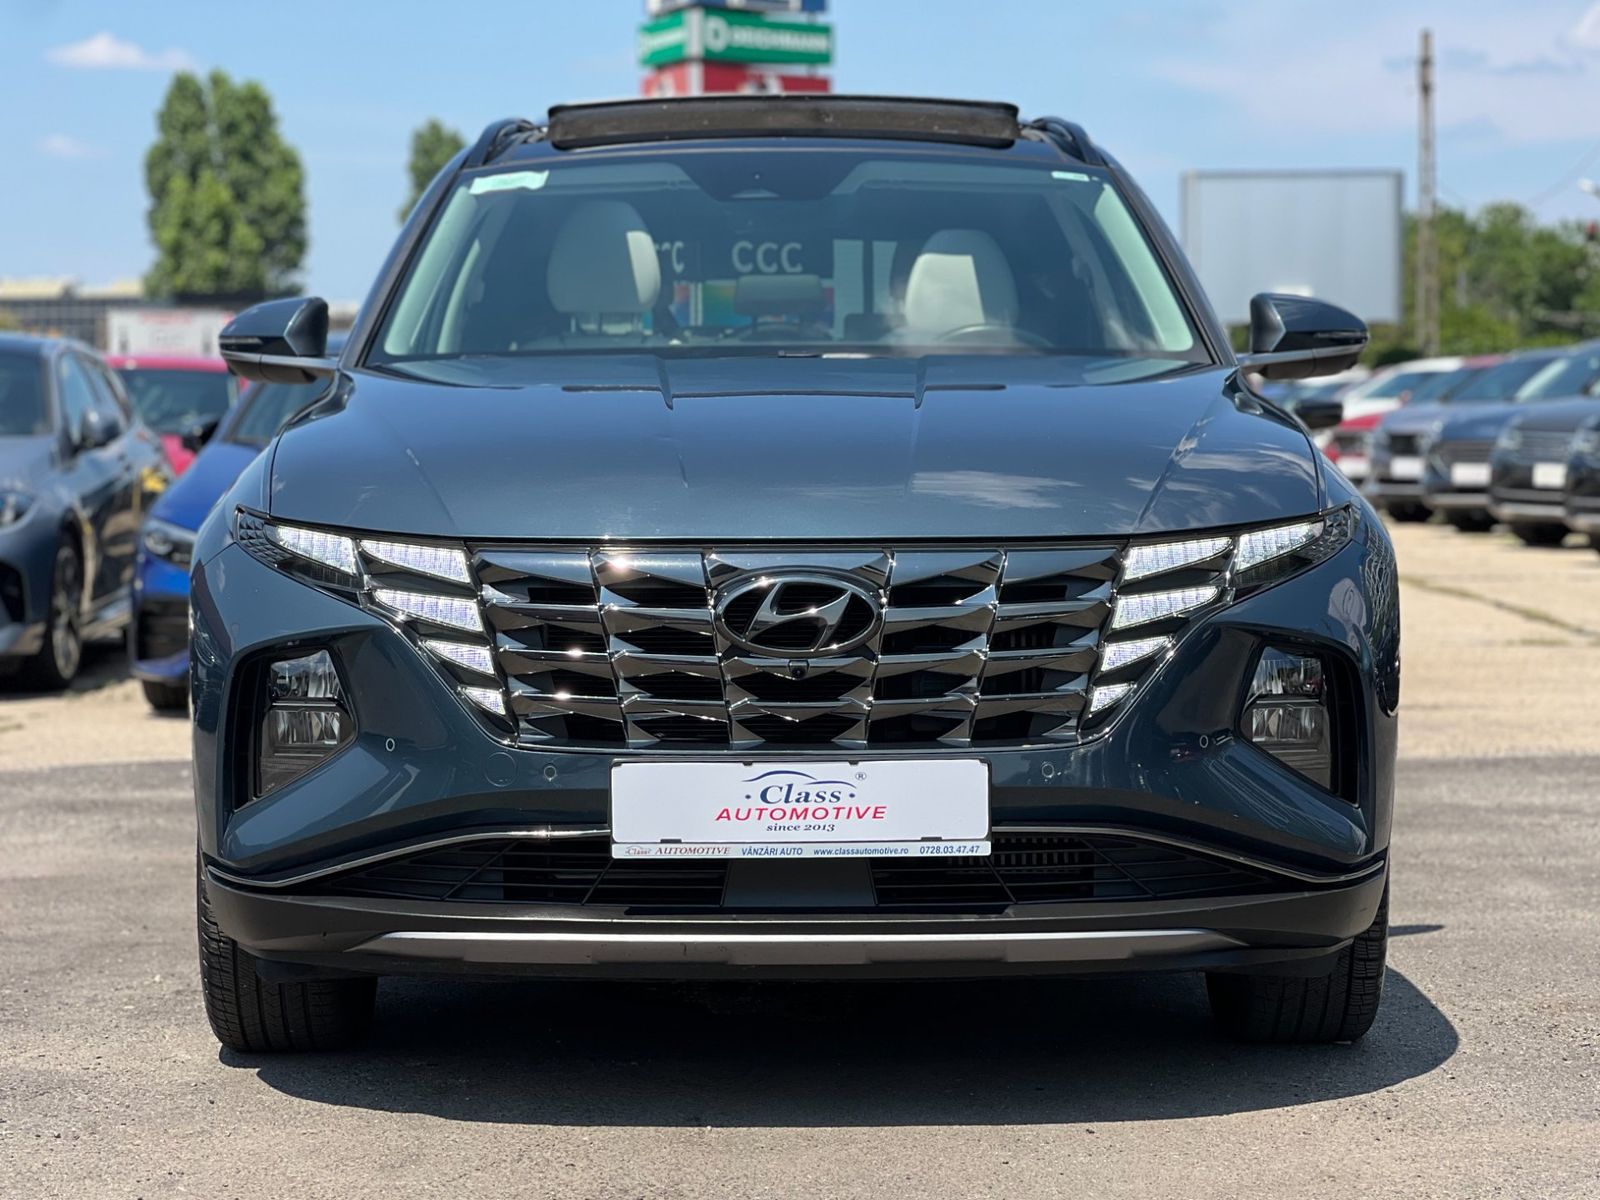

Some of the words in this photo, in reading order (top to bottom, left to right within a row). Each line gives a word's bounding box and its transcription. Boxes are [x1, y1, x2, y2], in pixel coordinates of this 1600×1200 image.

[731, 240, 803, 274] CCC
[760, 783, 842, 805] Class
[716, 806, 886, 821] AUTOMOTIVE
[766, 823, 800, 832] since
[804, 823, 835, 832] 2013
[655, 847, 731, 856] AUTOMOTIVE
[779, 847, 803, 856] AUTO
[813, 846, 909, 856] www.classautomotive.ro
[919, 845, 980, 855] 0728.03.47.47
